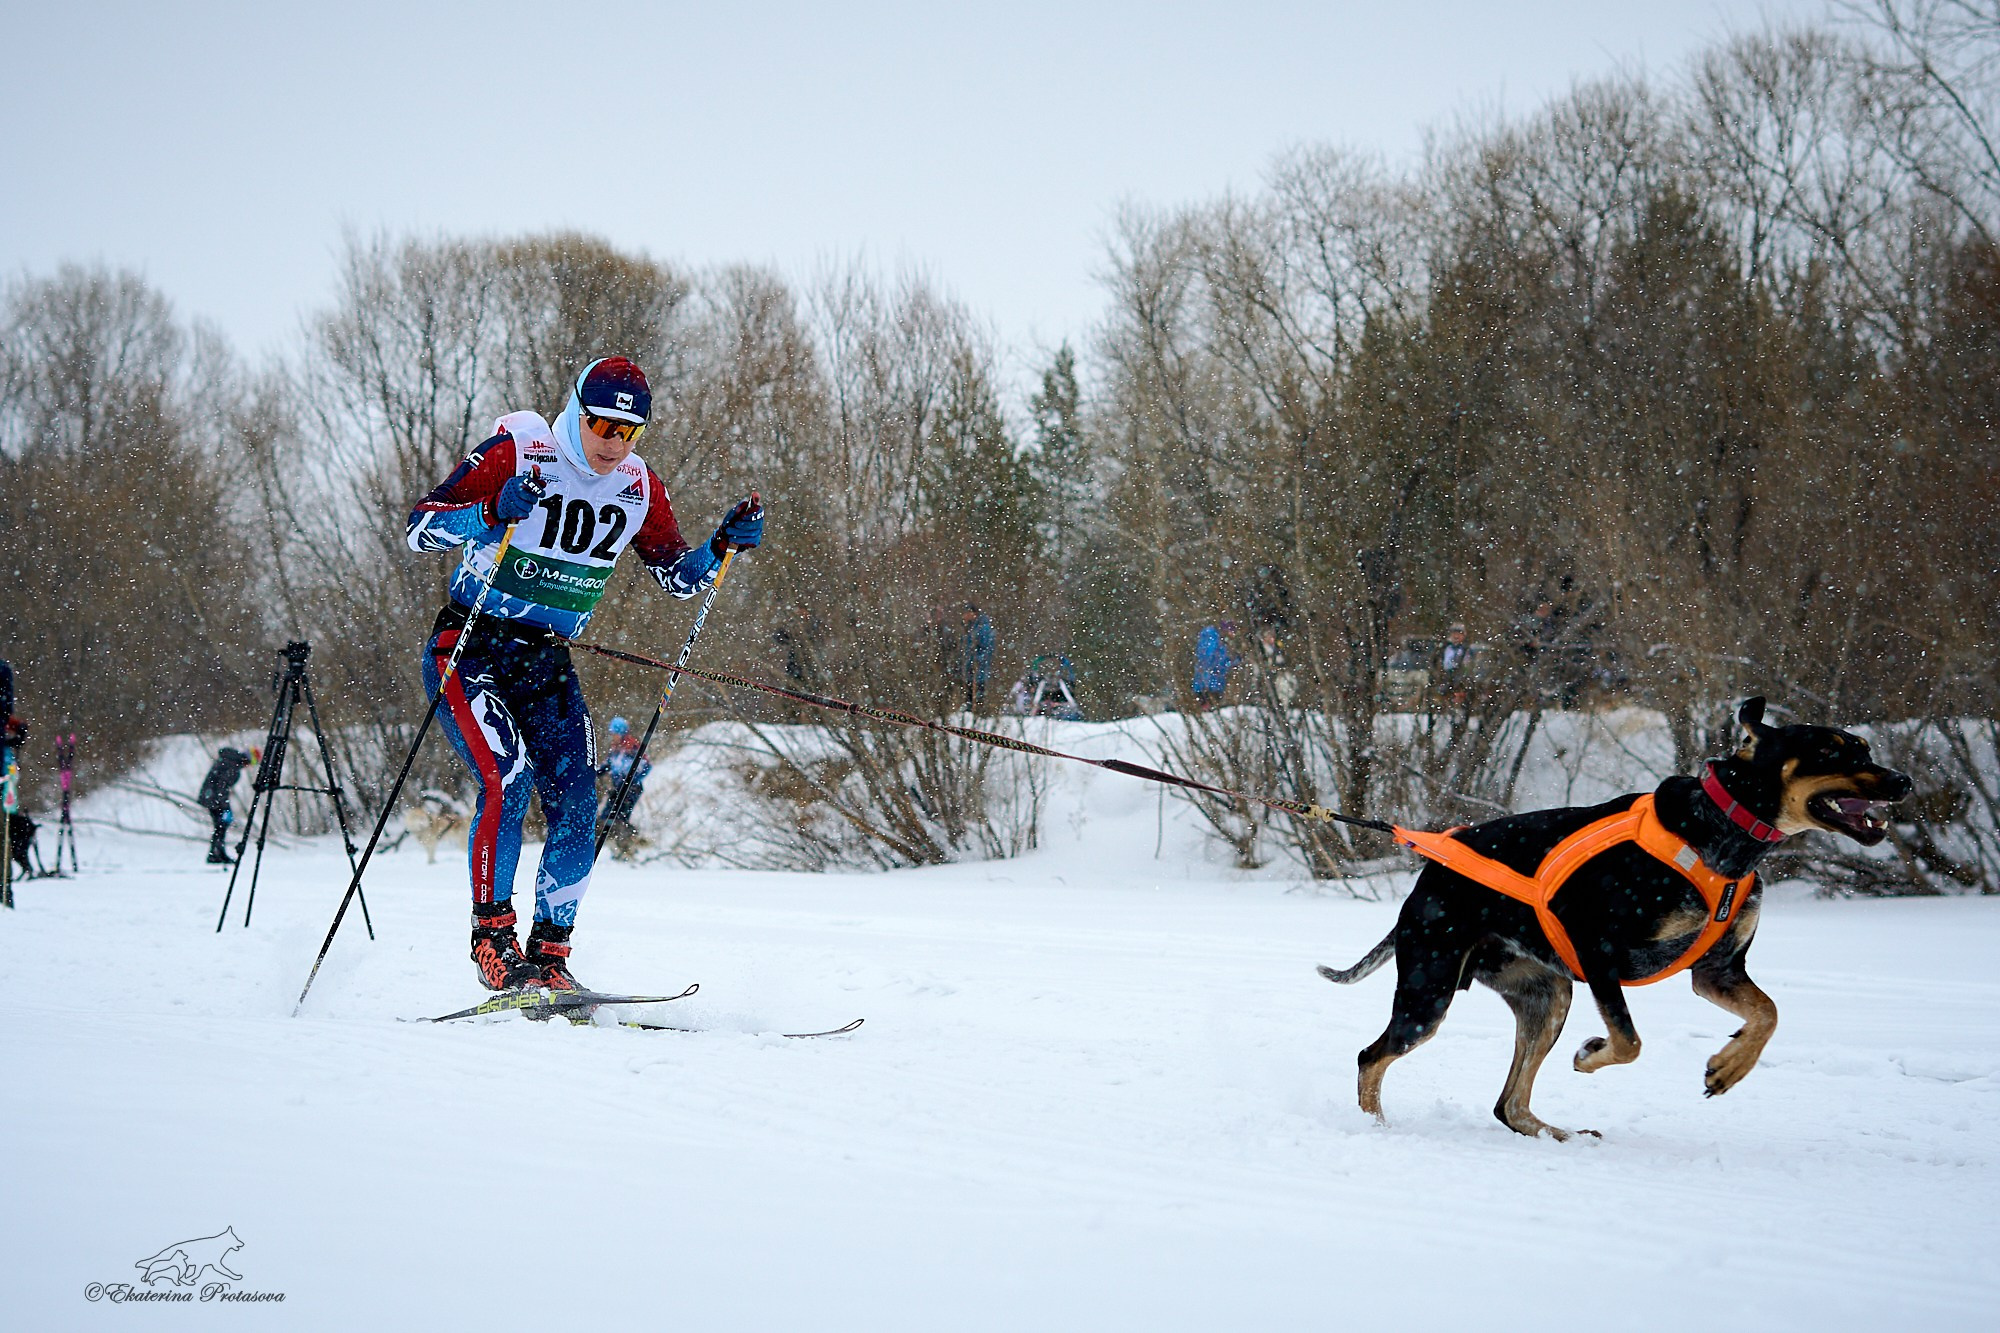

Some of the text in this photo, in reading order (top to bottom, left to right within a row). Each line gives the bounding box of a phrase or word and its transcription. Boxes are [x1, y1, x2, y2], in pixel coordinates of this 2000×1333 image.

[523, 478, 543, 495] LEKI
[538, 493, 627, 561] 102
[539, 579, 568, 592] Будущее
[481, 845, 490, 881] VICTORY
[477, 993, 540, 1015] FISCHER
